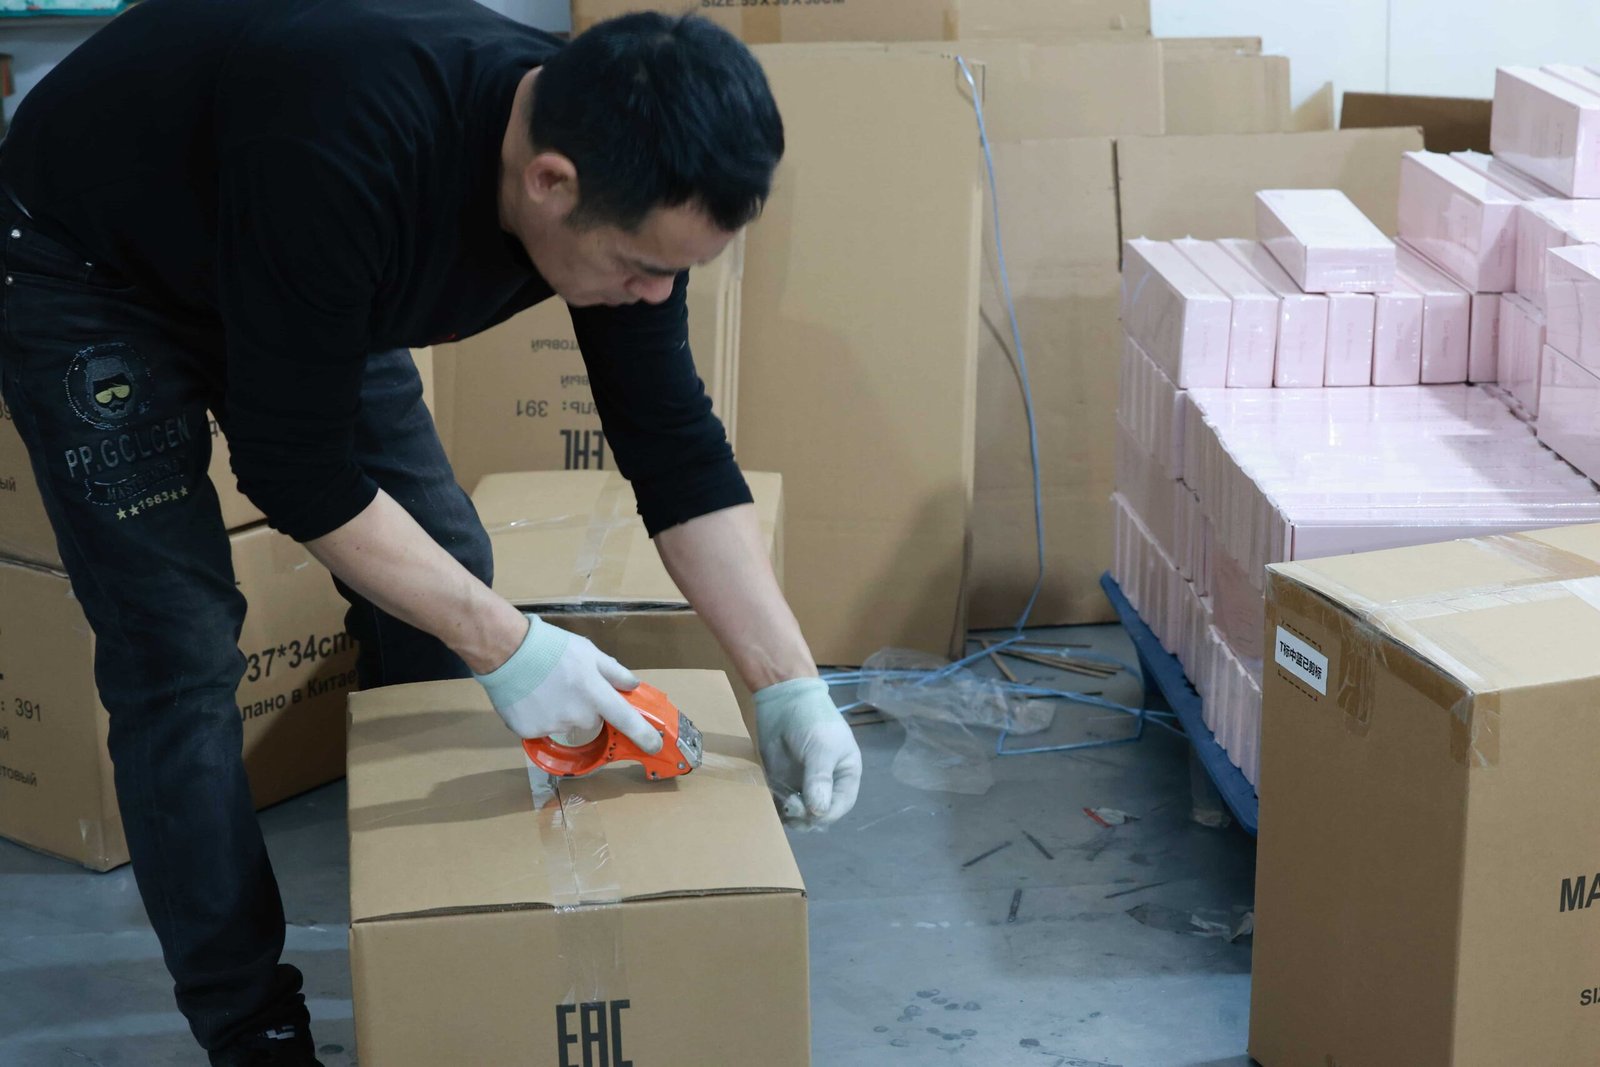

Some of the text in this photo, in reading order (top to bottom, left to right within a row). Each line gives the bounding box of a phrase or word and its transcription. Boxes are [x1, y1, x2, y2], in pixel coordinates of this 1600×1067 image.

[531, 339, 580, 352] товый
[515, 400, 549, 418] 391
[291, 688, 303, 704] в
[307, 668, 357, 698] Китае
[15, 697, 41, 722] 391
[556, 999, 633, 1067] EAC
